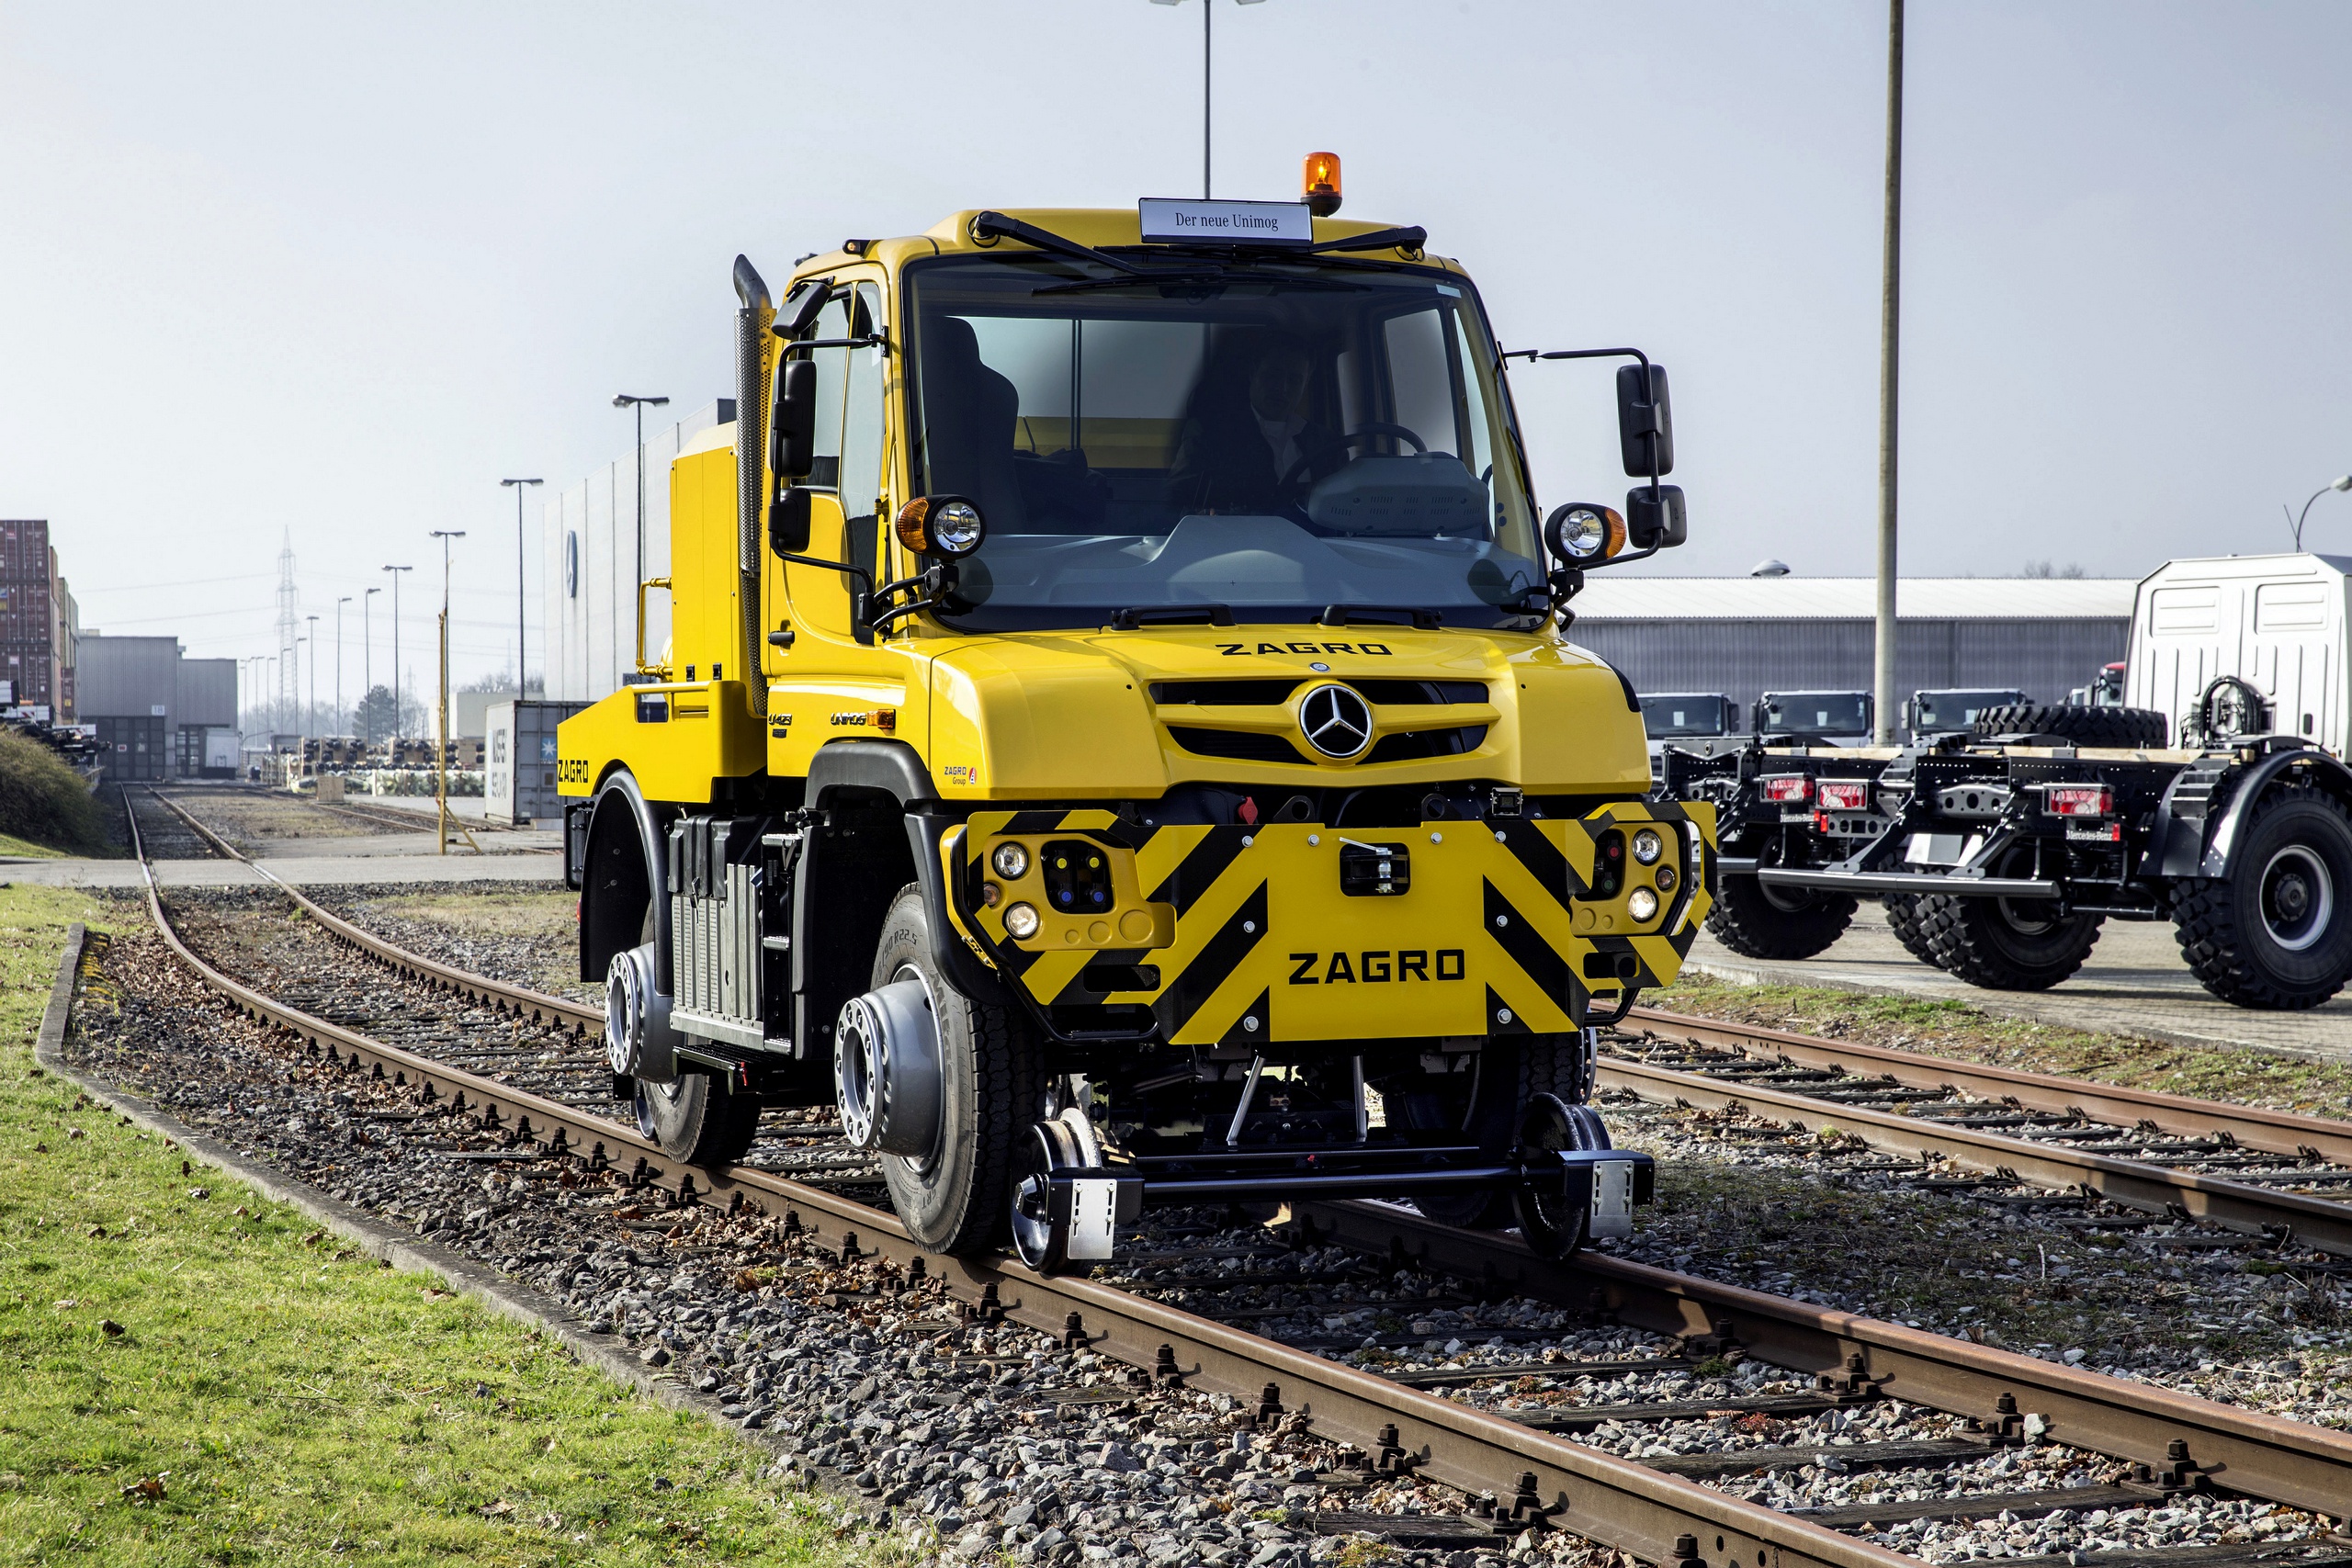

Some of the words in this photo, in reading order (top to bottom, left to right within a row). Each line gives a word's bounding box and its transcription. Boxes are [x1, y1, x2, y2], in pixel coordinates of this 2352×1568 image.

[1176, 212, 1197, 227] Der
[1201, 216, 1229, 228] neue
[1232, 214, 1279, 231] Unimog
[1215, 642, 1393, 656] ZAGRO
[831, 712, 866, 726] UNIMOG
[558, 760, 589, 784] ZAGRO
[944, 766, 967, 775] ZAGRO
[952, 776, 967, 787] Group
[2065, 829, 2113, 840] Mercedes-Benz
[1288, 948, 1465, 985] ZAGRO
